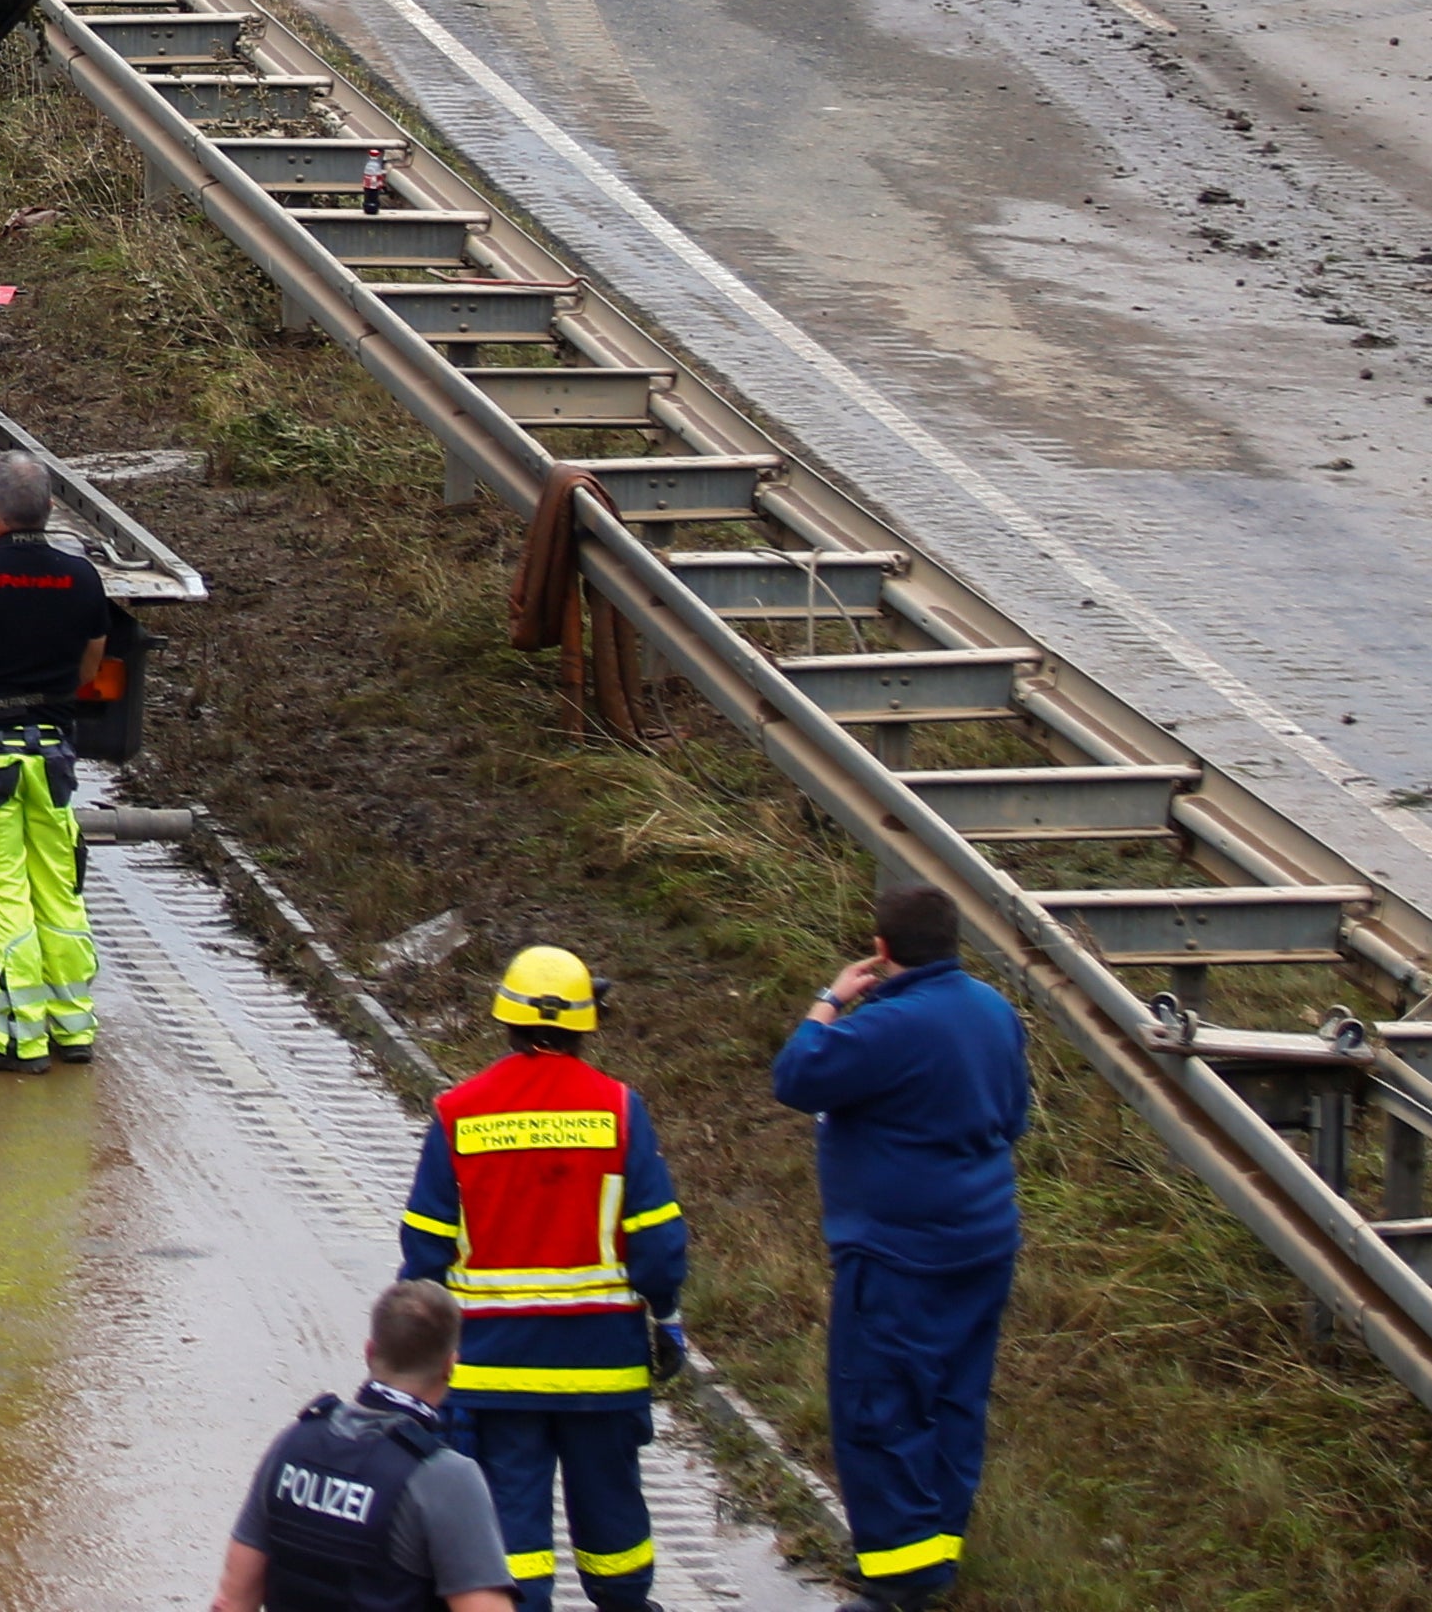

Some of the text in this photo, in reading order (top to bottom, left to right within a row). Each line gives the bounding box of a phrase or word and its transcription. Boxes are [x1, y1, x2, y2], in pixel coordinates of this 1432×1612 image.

[460, 1116, 613, 1136] GRUPPENFÜHRER
[481, 1130, 588, 1146] THW BRÜHL
[276, 1461, 375, 1525] POLIZEI
